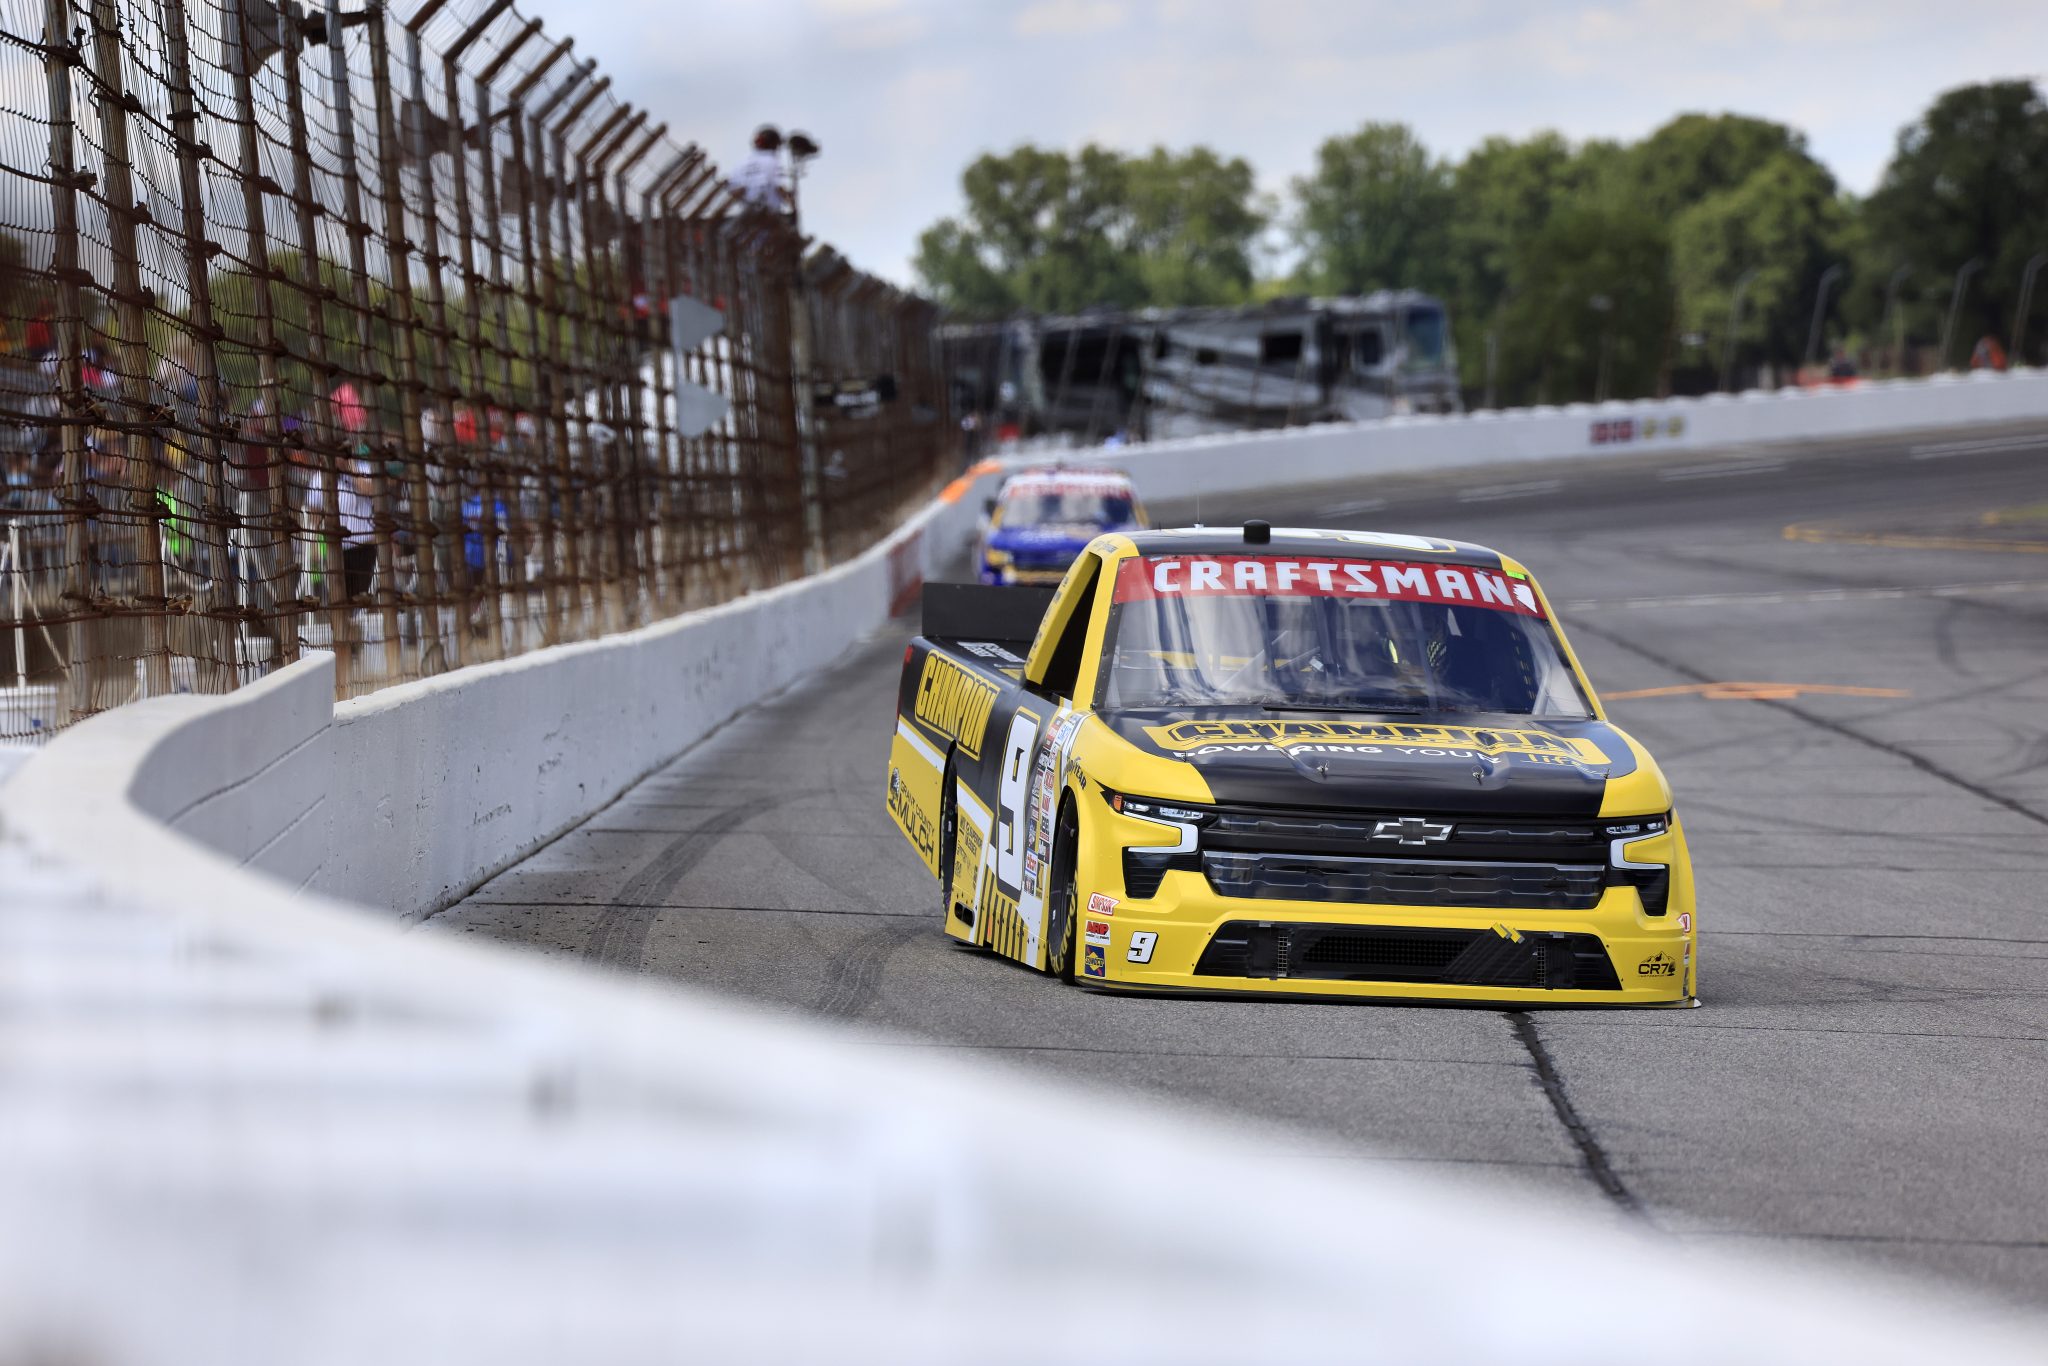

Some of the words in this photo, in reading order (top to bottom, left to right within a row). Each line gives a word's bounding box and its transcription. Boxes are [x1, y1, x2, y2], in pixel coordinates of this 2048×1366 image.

[1153, 560, 1515, 607] CRAFTSMAN
[916, 652, 998, 757] CHAMPION
[1169, 722, 1584, 760] CHAMPION
[1173, 744, 1383, 758] POWERING
[1394, 747, 1501, 764] YOUR
[998, 712, 1038, 891] 9
[896, 793, 935, 864] MULCH
[1086, 921, 1109, 936] ARP
[1127, 931, 1159, 964] 9
[1638, 963, 1669, 975] CR7
